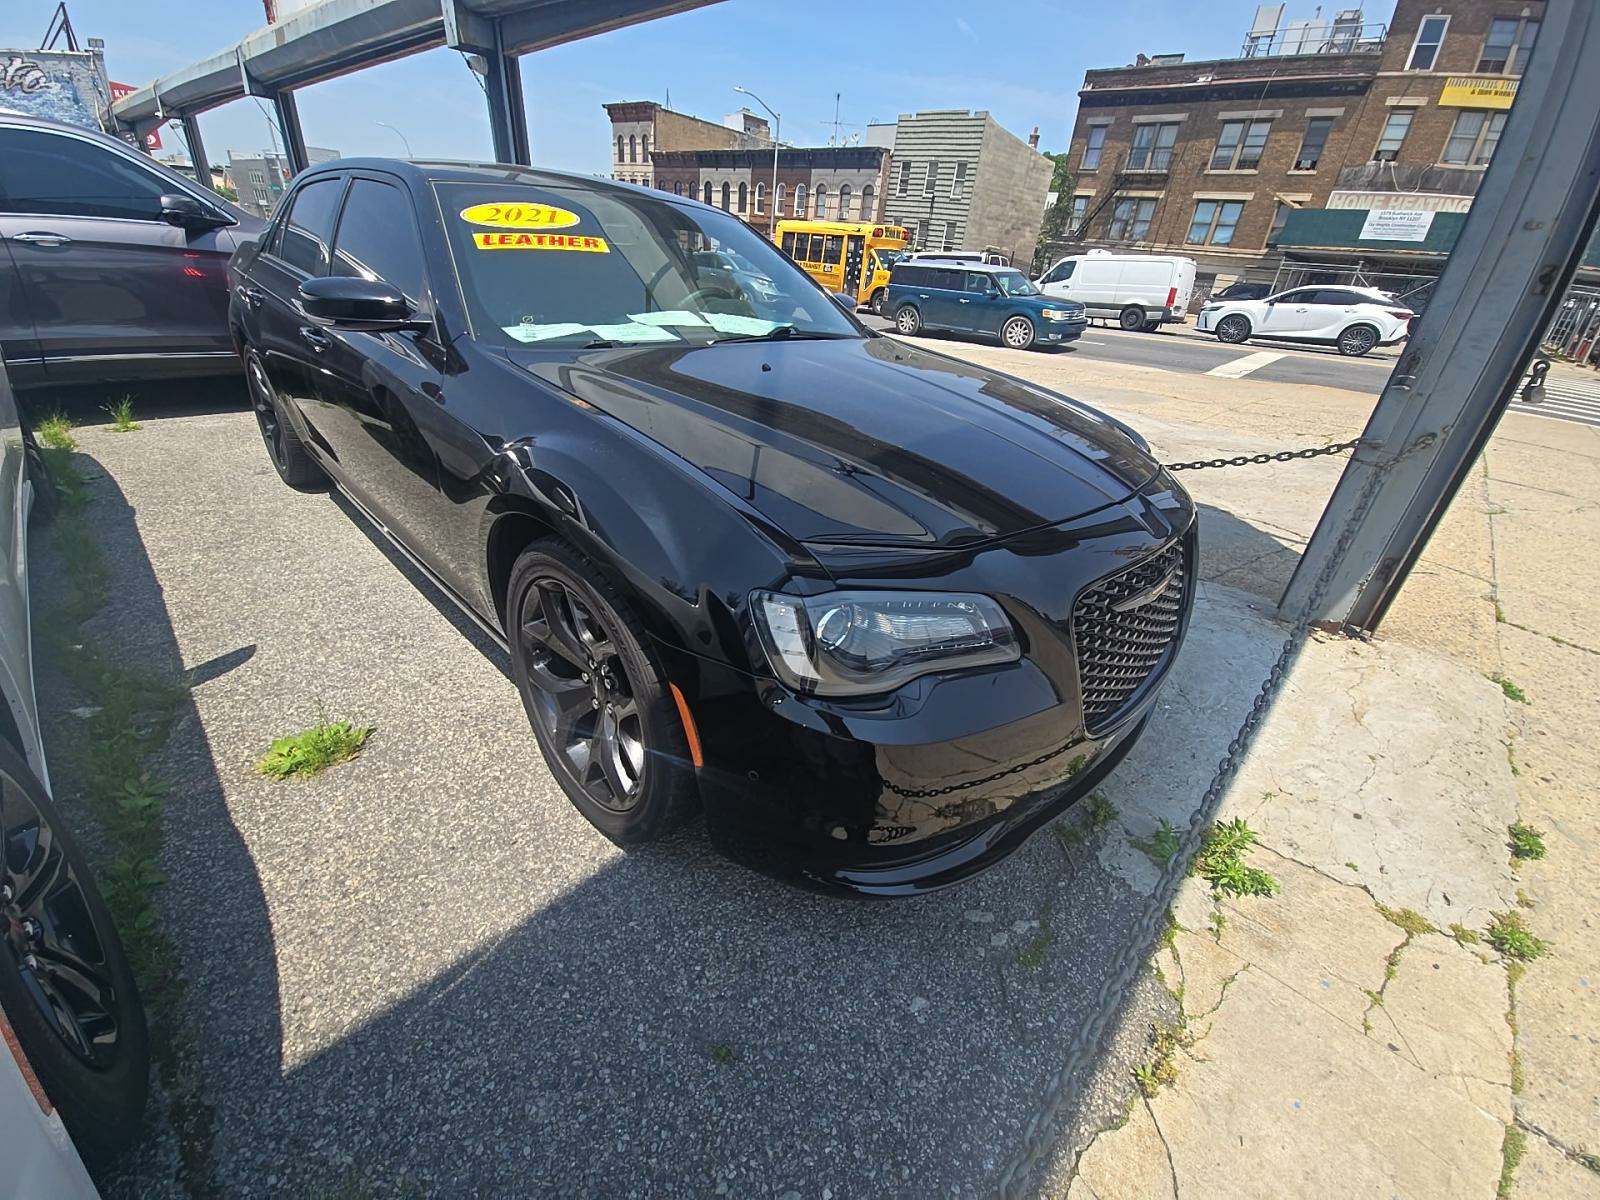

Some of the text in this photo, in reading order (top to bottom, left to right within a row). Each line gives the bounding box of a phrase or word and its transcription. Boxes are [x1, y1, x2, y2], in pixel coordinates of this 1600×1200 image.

[1330, 194, 1472, 212] HOME HEATING
[484, 207, 558, 224] 2021
[482, 234, 599, 248] LEATHER
[803, 262, 822, 270] TRANSIT
